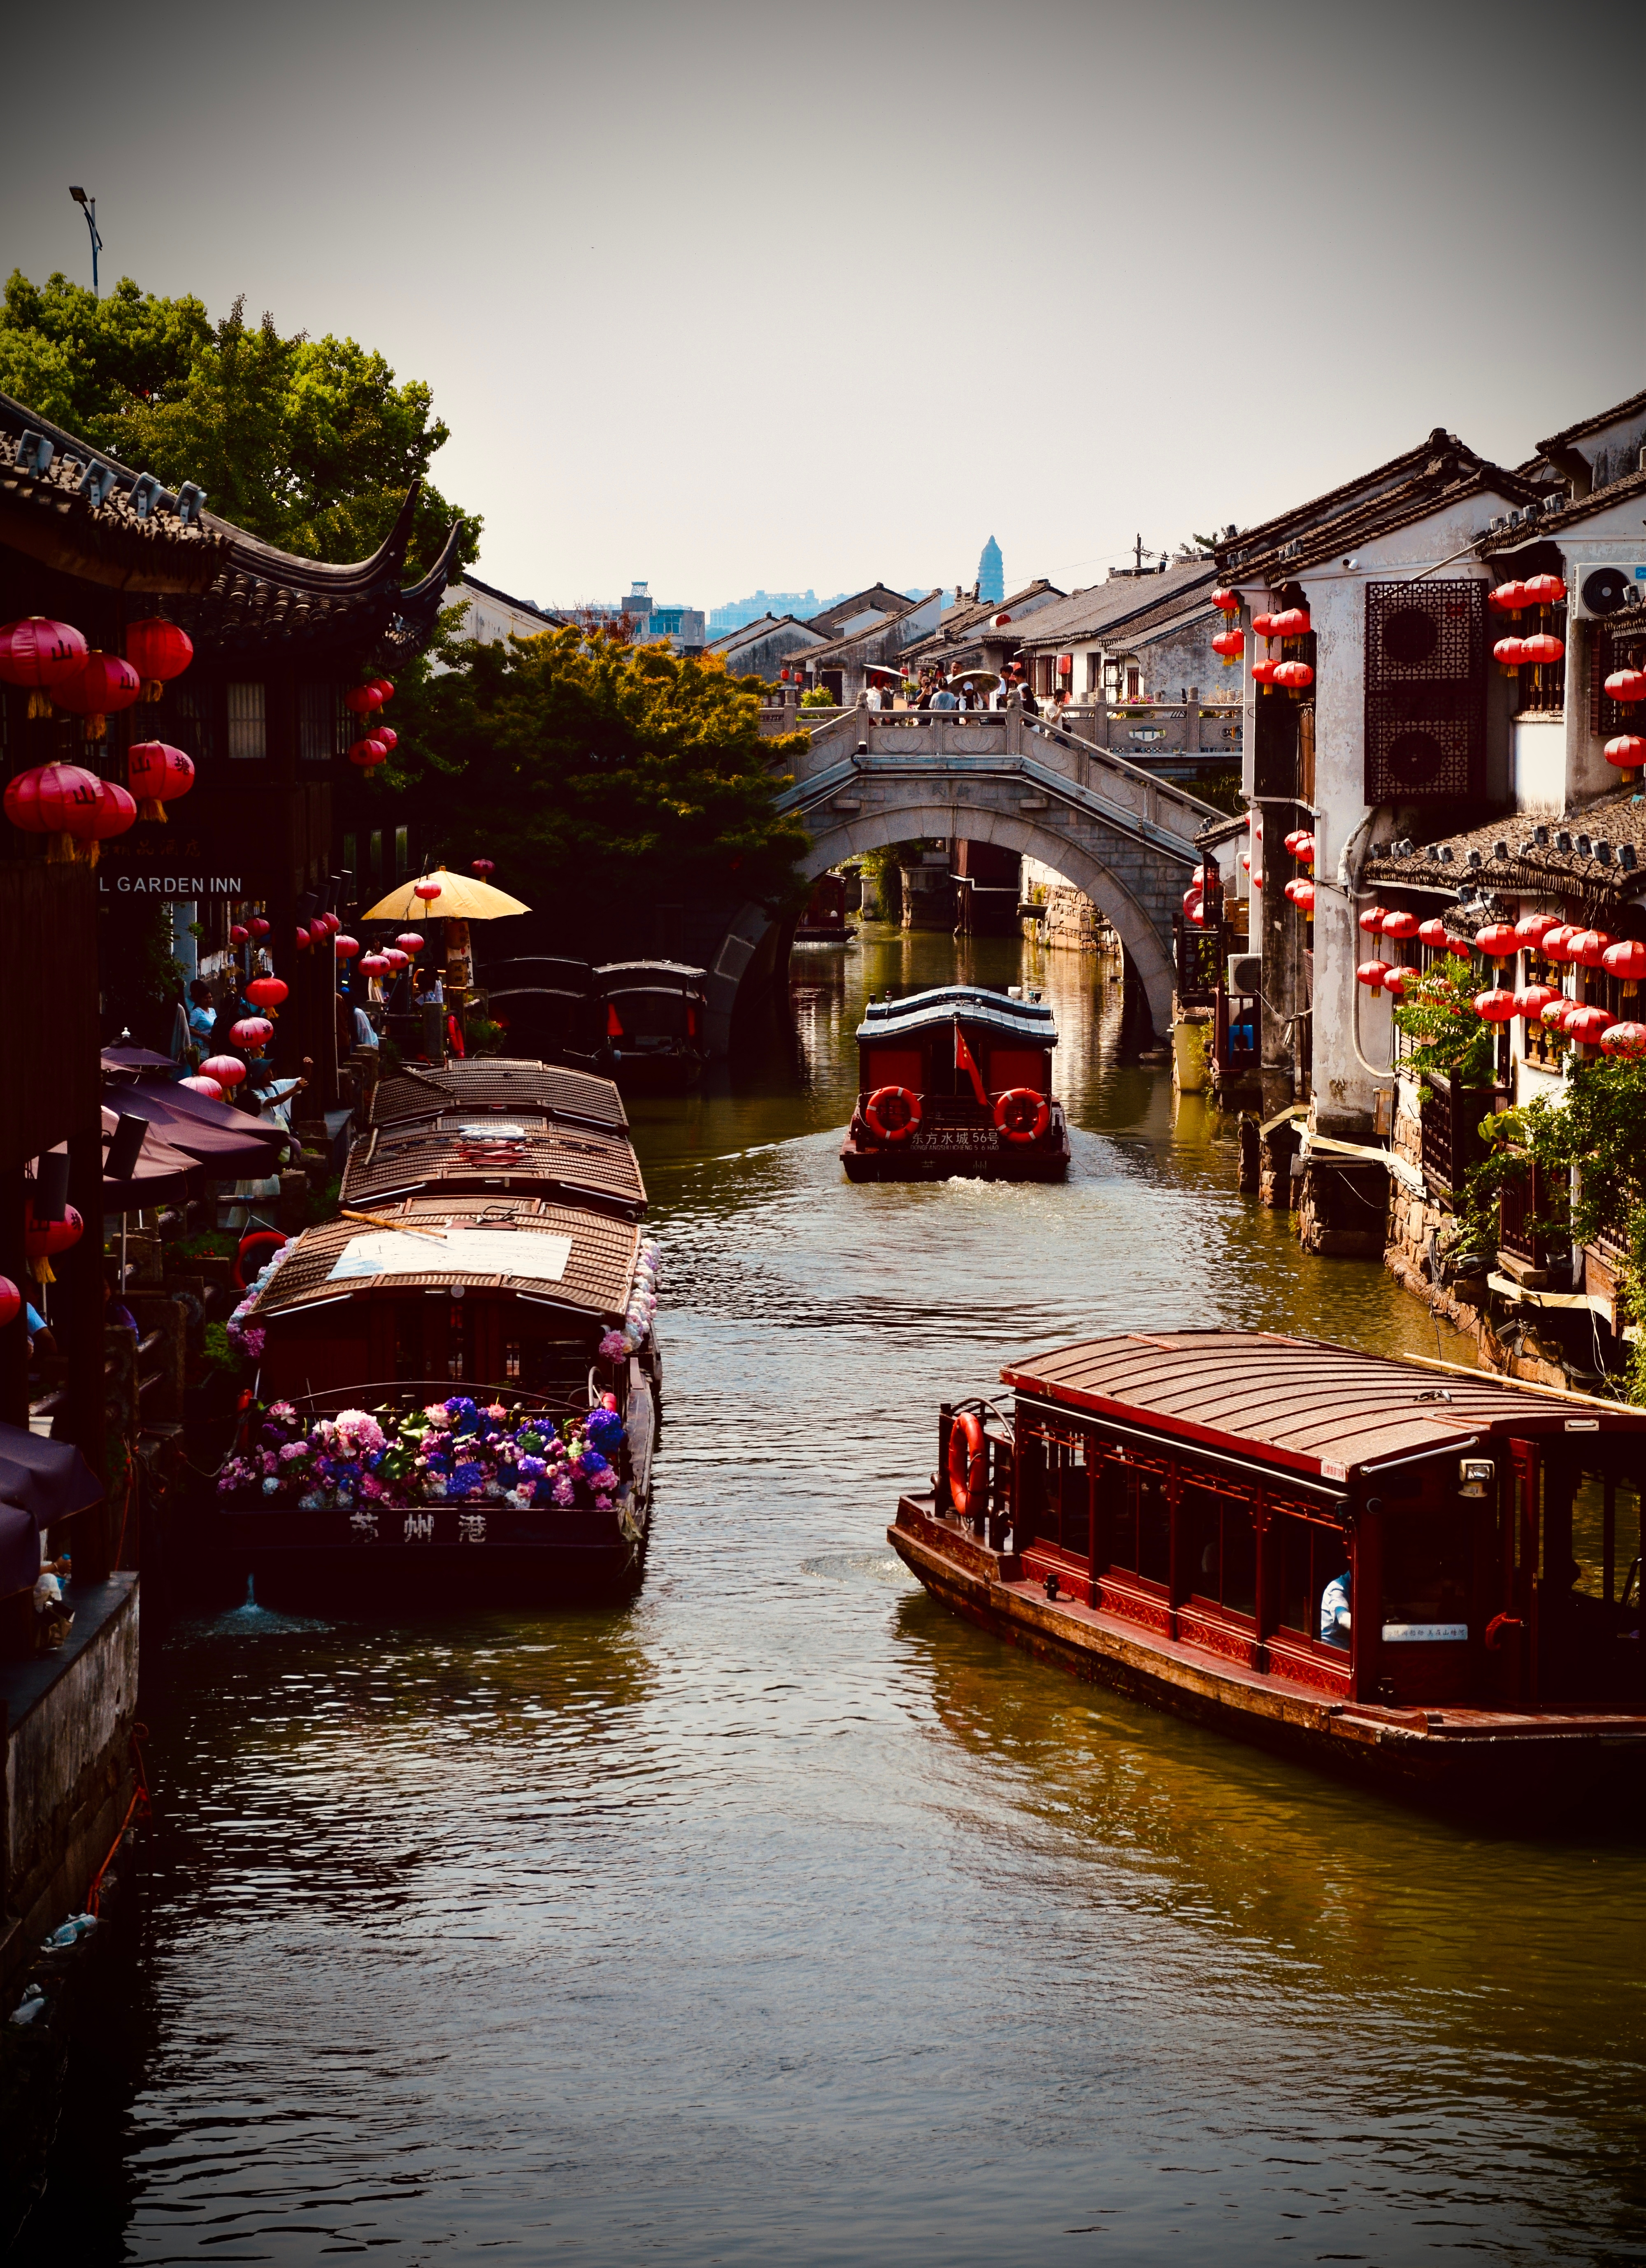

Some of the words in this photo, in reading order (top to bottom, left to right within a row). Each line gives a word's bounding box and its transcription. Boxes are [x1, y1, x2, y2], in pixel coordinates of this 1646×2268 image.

[51, 640, 73, 661] 山
[120, 672, 135, 690] 山
[73, 785, 96, 805] 山
[117, 877, 204, 893] GARDEN
[211, 877, 241, 893] INN
